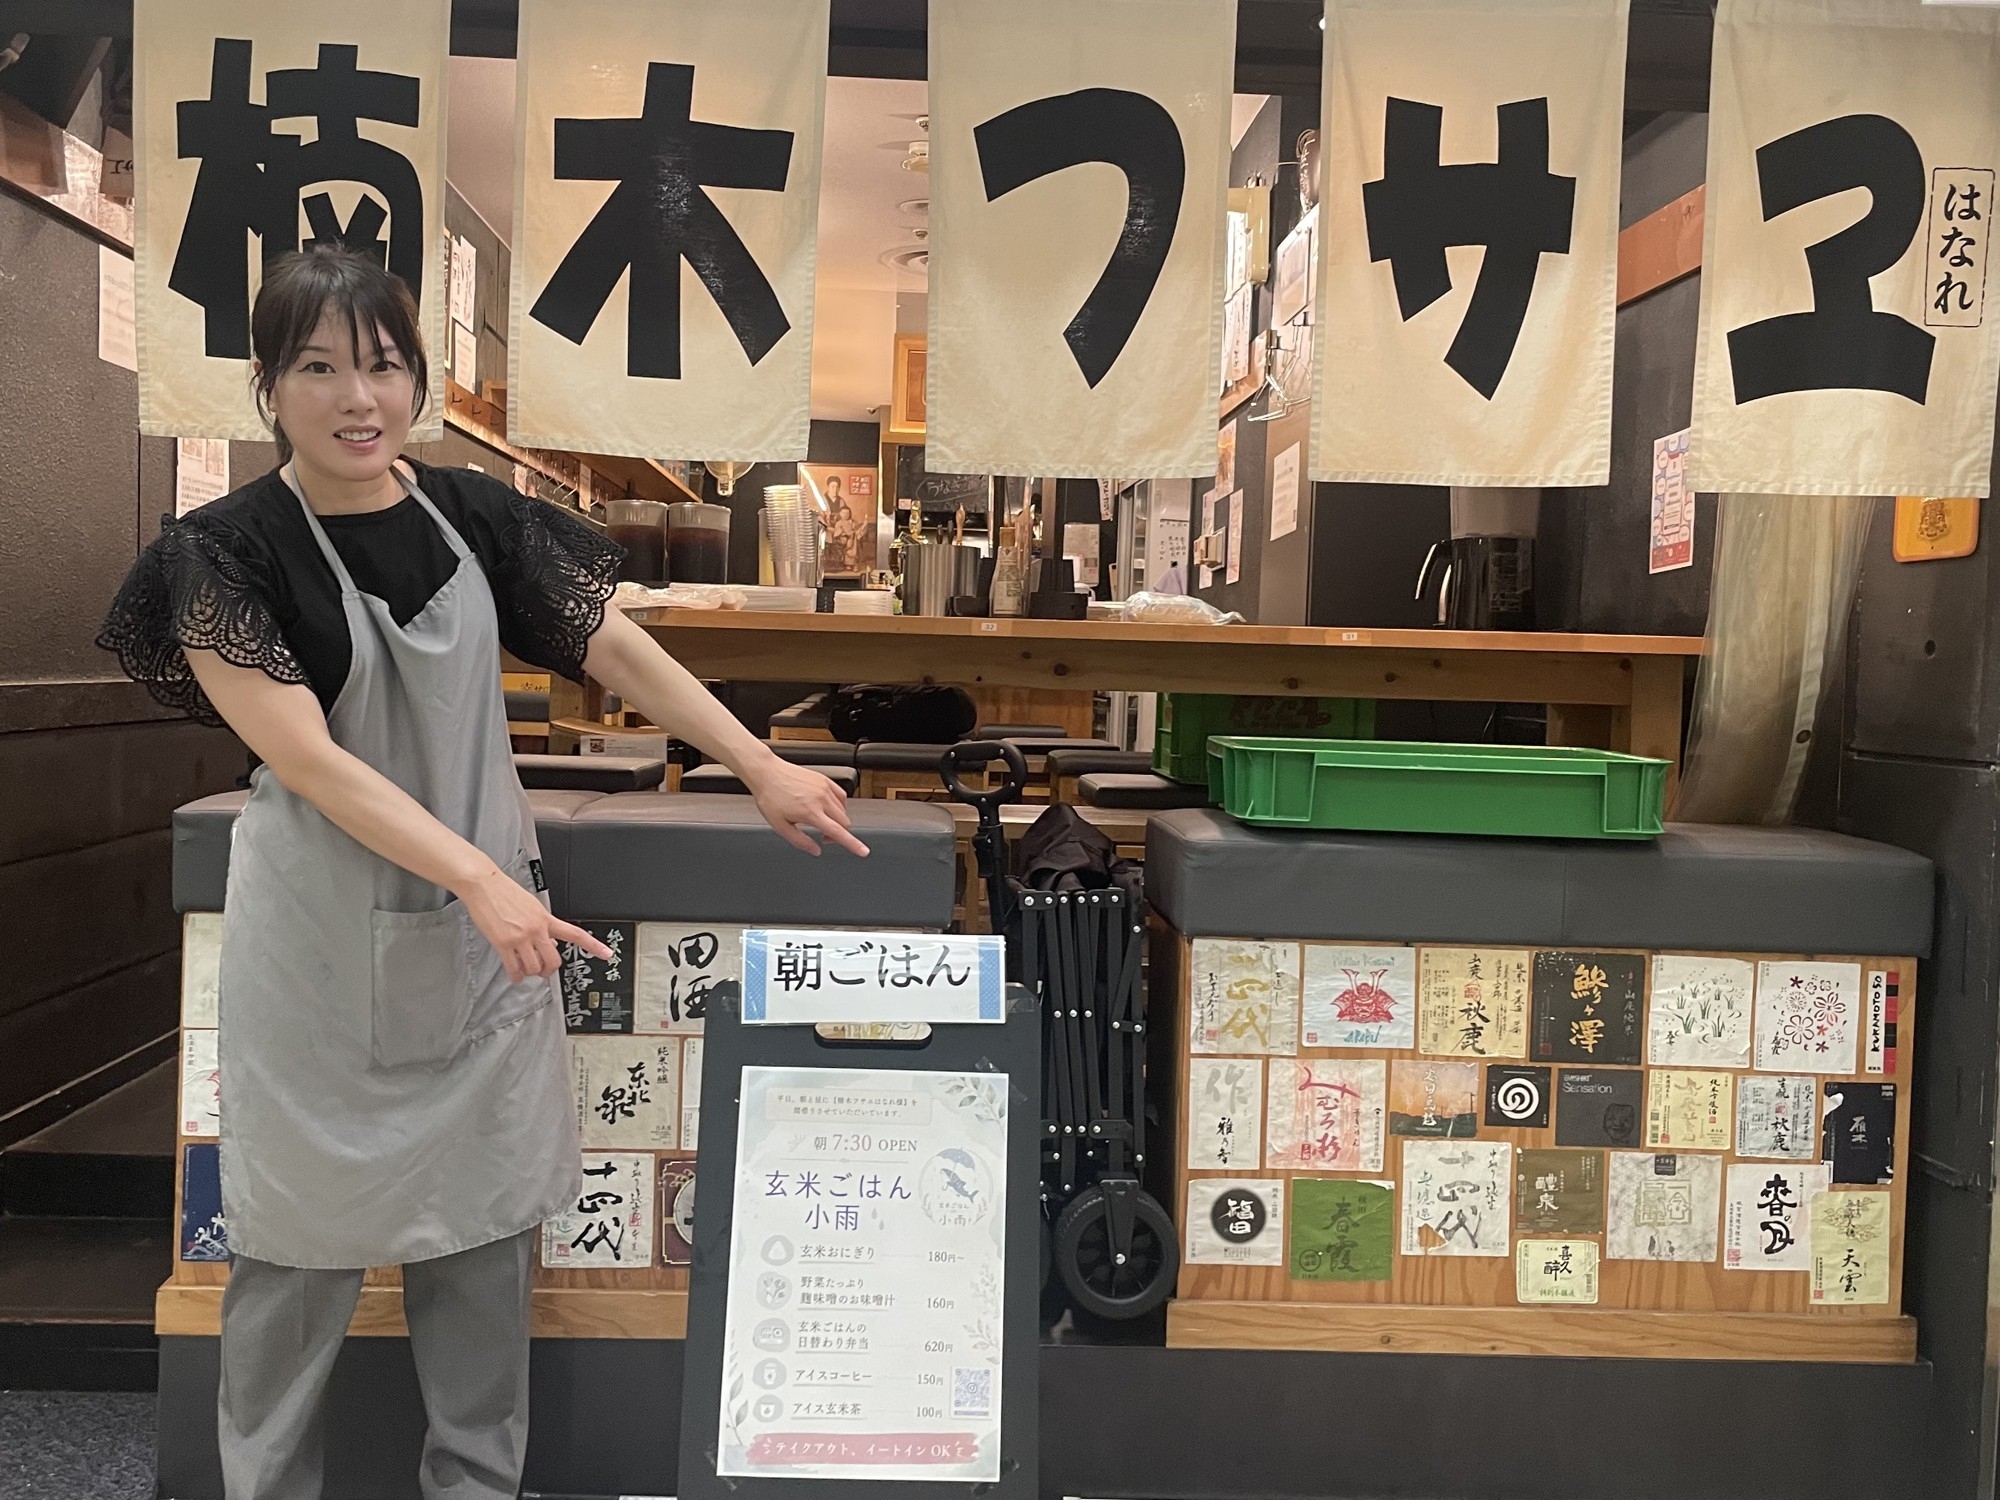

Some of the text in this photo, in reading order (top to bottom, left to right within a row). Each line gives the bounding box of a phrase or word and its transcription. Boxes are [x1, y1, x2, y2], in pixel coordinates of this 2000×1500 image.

[1932, 183, 1983, 314] はなれ
[774, 941, 971, 991] 朝ごはん
[1871, 974, 1883, 1052] KURAMOTO 50
[1563, 1082, 1612, 1093] Sensation
[814, 1134, 917, 1151] 朝 7:30 OPEN
[765, 1170, 912, 1199] 玄米ごはん
[805, 1203, 860, 1230] 小雨
[800, 1245, 875, 1259] 玄米おにぎり
[800, 1276, 864, 1288] 野菜たっぷり
[926, 1298, 955, 1309] 160円
[798, 1321, 867, 1333] 玄米ごはんの
[798, 1336, 870, 1350] 日替わり弁当
[924, 1341, 953, 1353] 620円
[794, 1369, 873, 1382] アイスコーヒー
[917, 1374, 944, 1386] 150円
[792, 1403, 862, 1416] アイス玄米茶
[916, 1407, 943, 1419] 100円
[931, 1444, 951, 1457] OK
